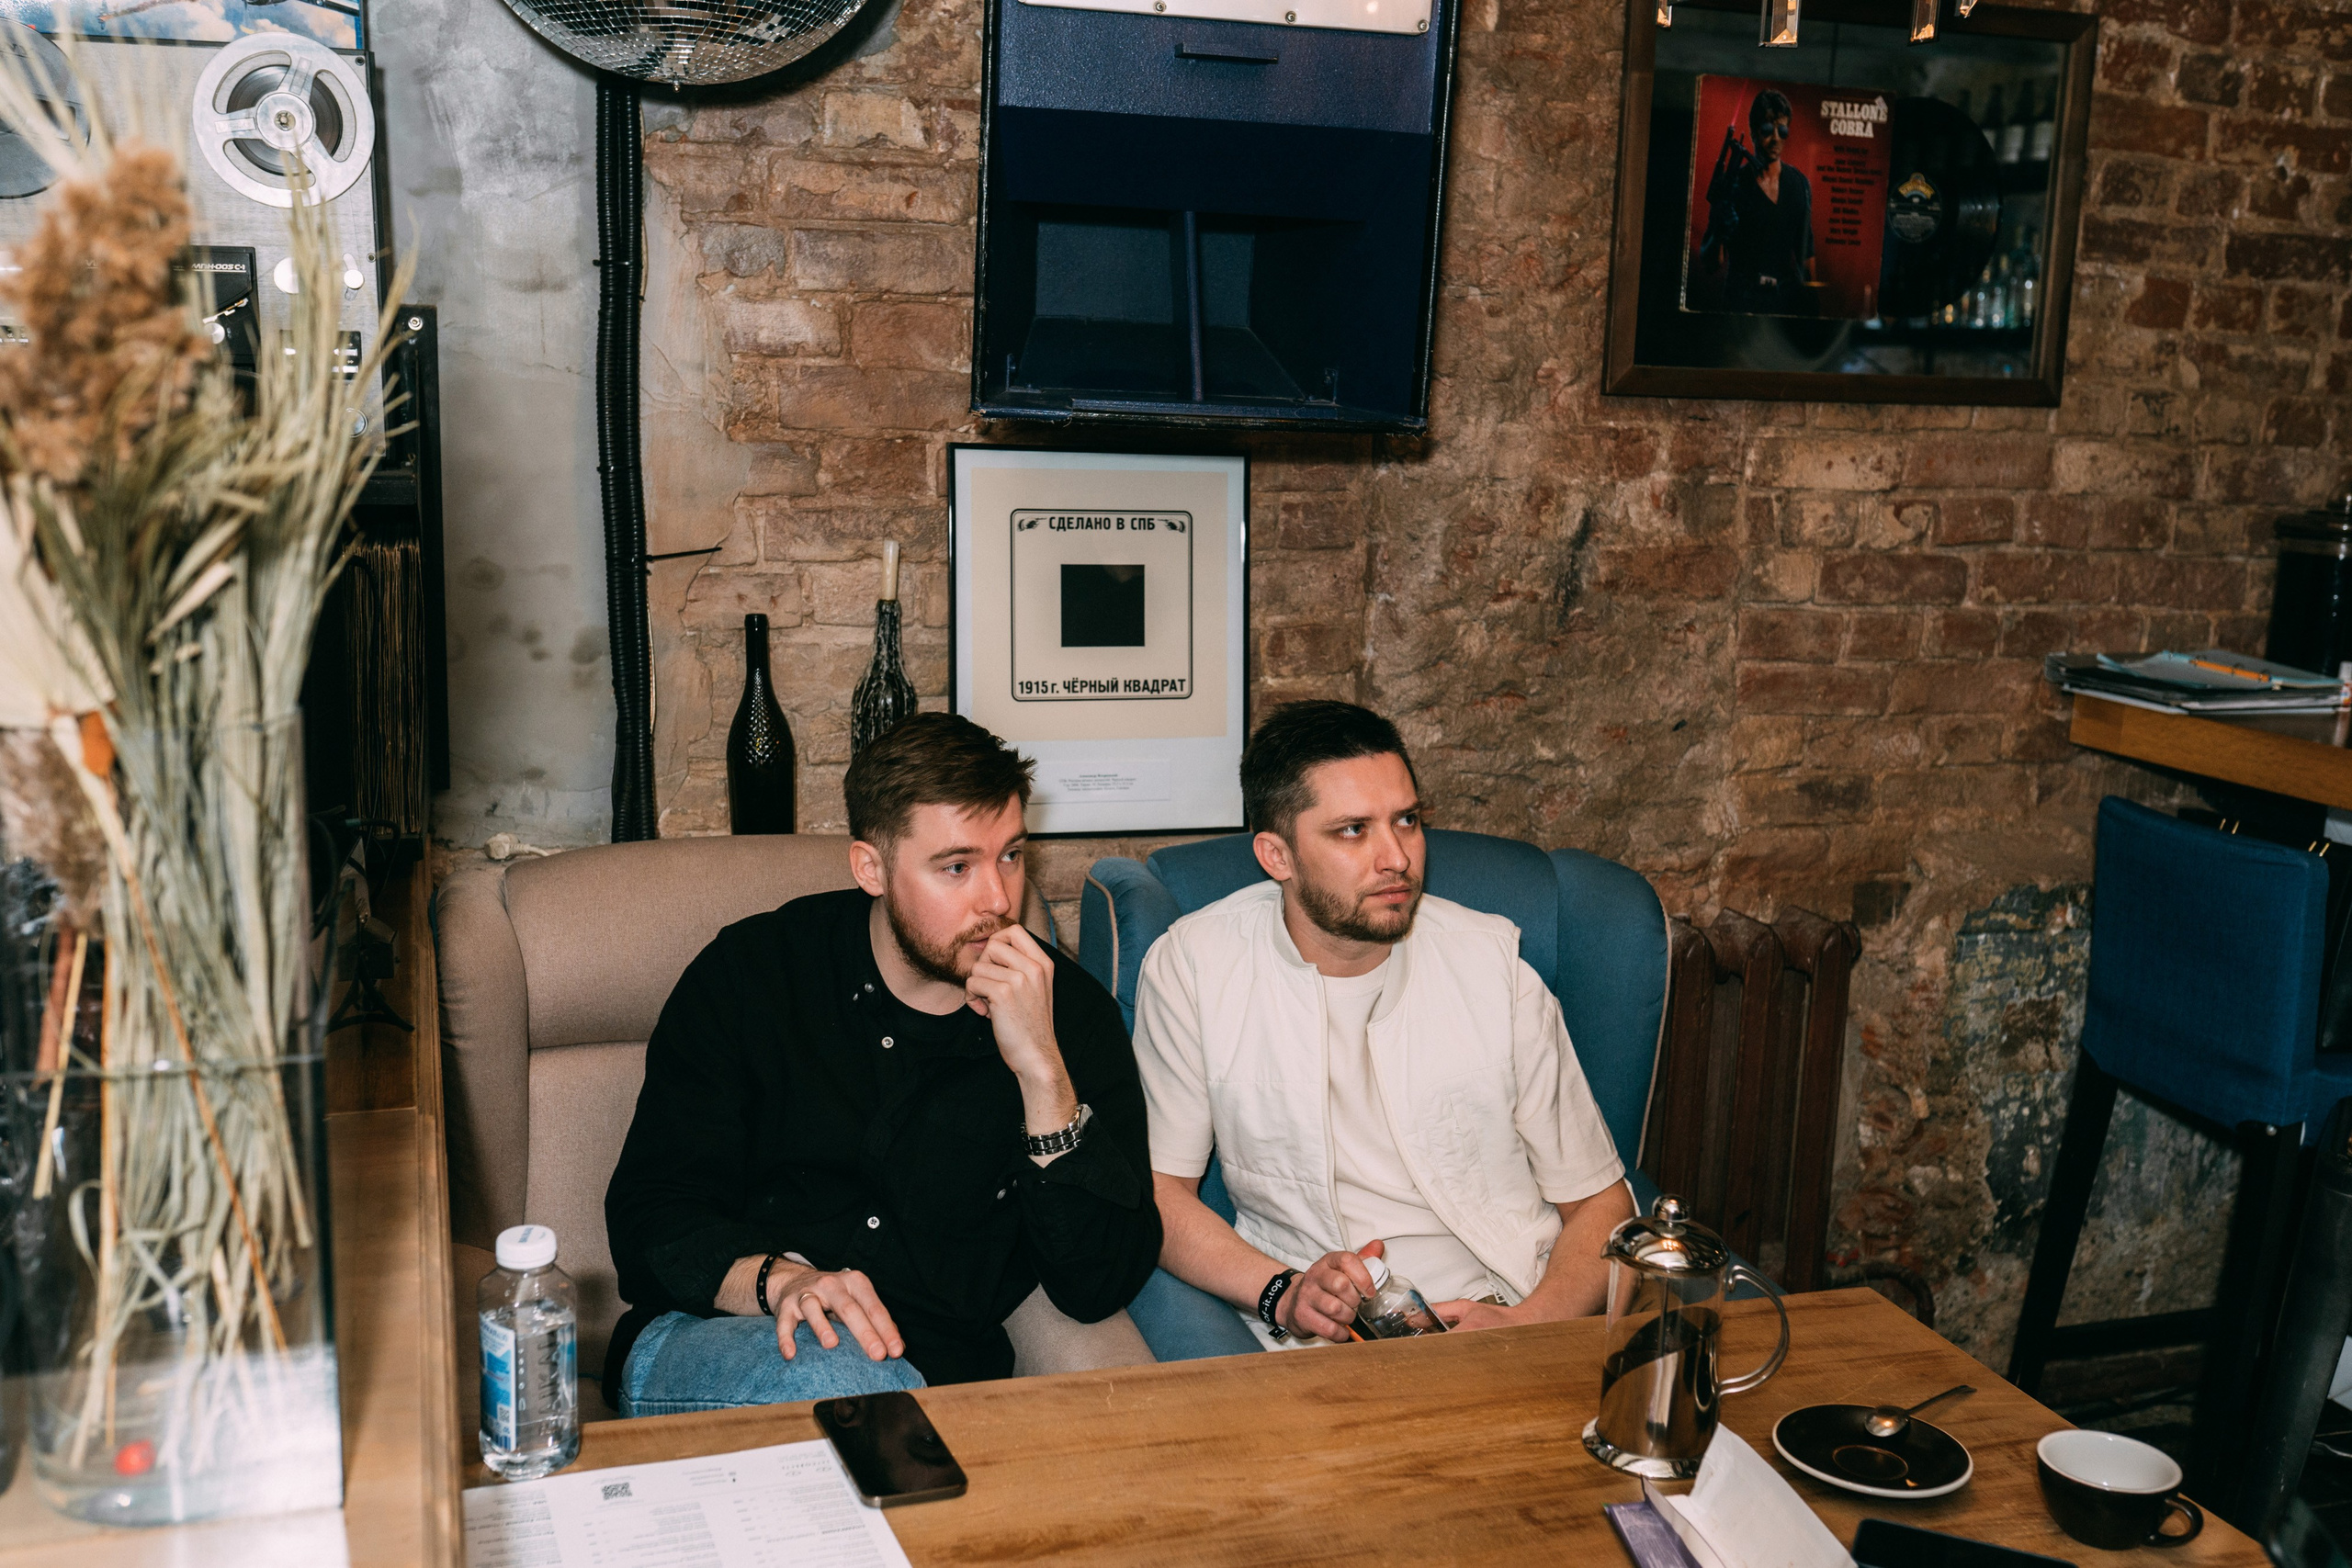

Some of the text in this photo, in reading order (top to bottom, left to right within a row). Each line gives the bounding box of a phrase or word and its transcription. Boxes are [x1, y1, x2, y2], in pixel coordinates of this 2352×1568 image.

[1820, 100, 1888, 124] STALLONE
[1830, 119, 1874, 139] COBRA
[1048, 516, 1156, 531] СДЕЛАНО В СПБ
[1018, 677, 1186, 694] 1915 г. ЧЁРНЫЙ КВАДРАТ
